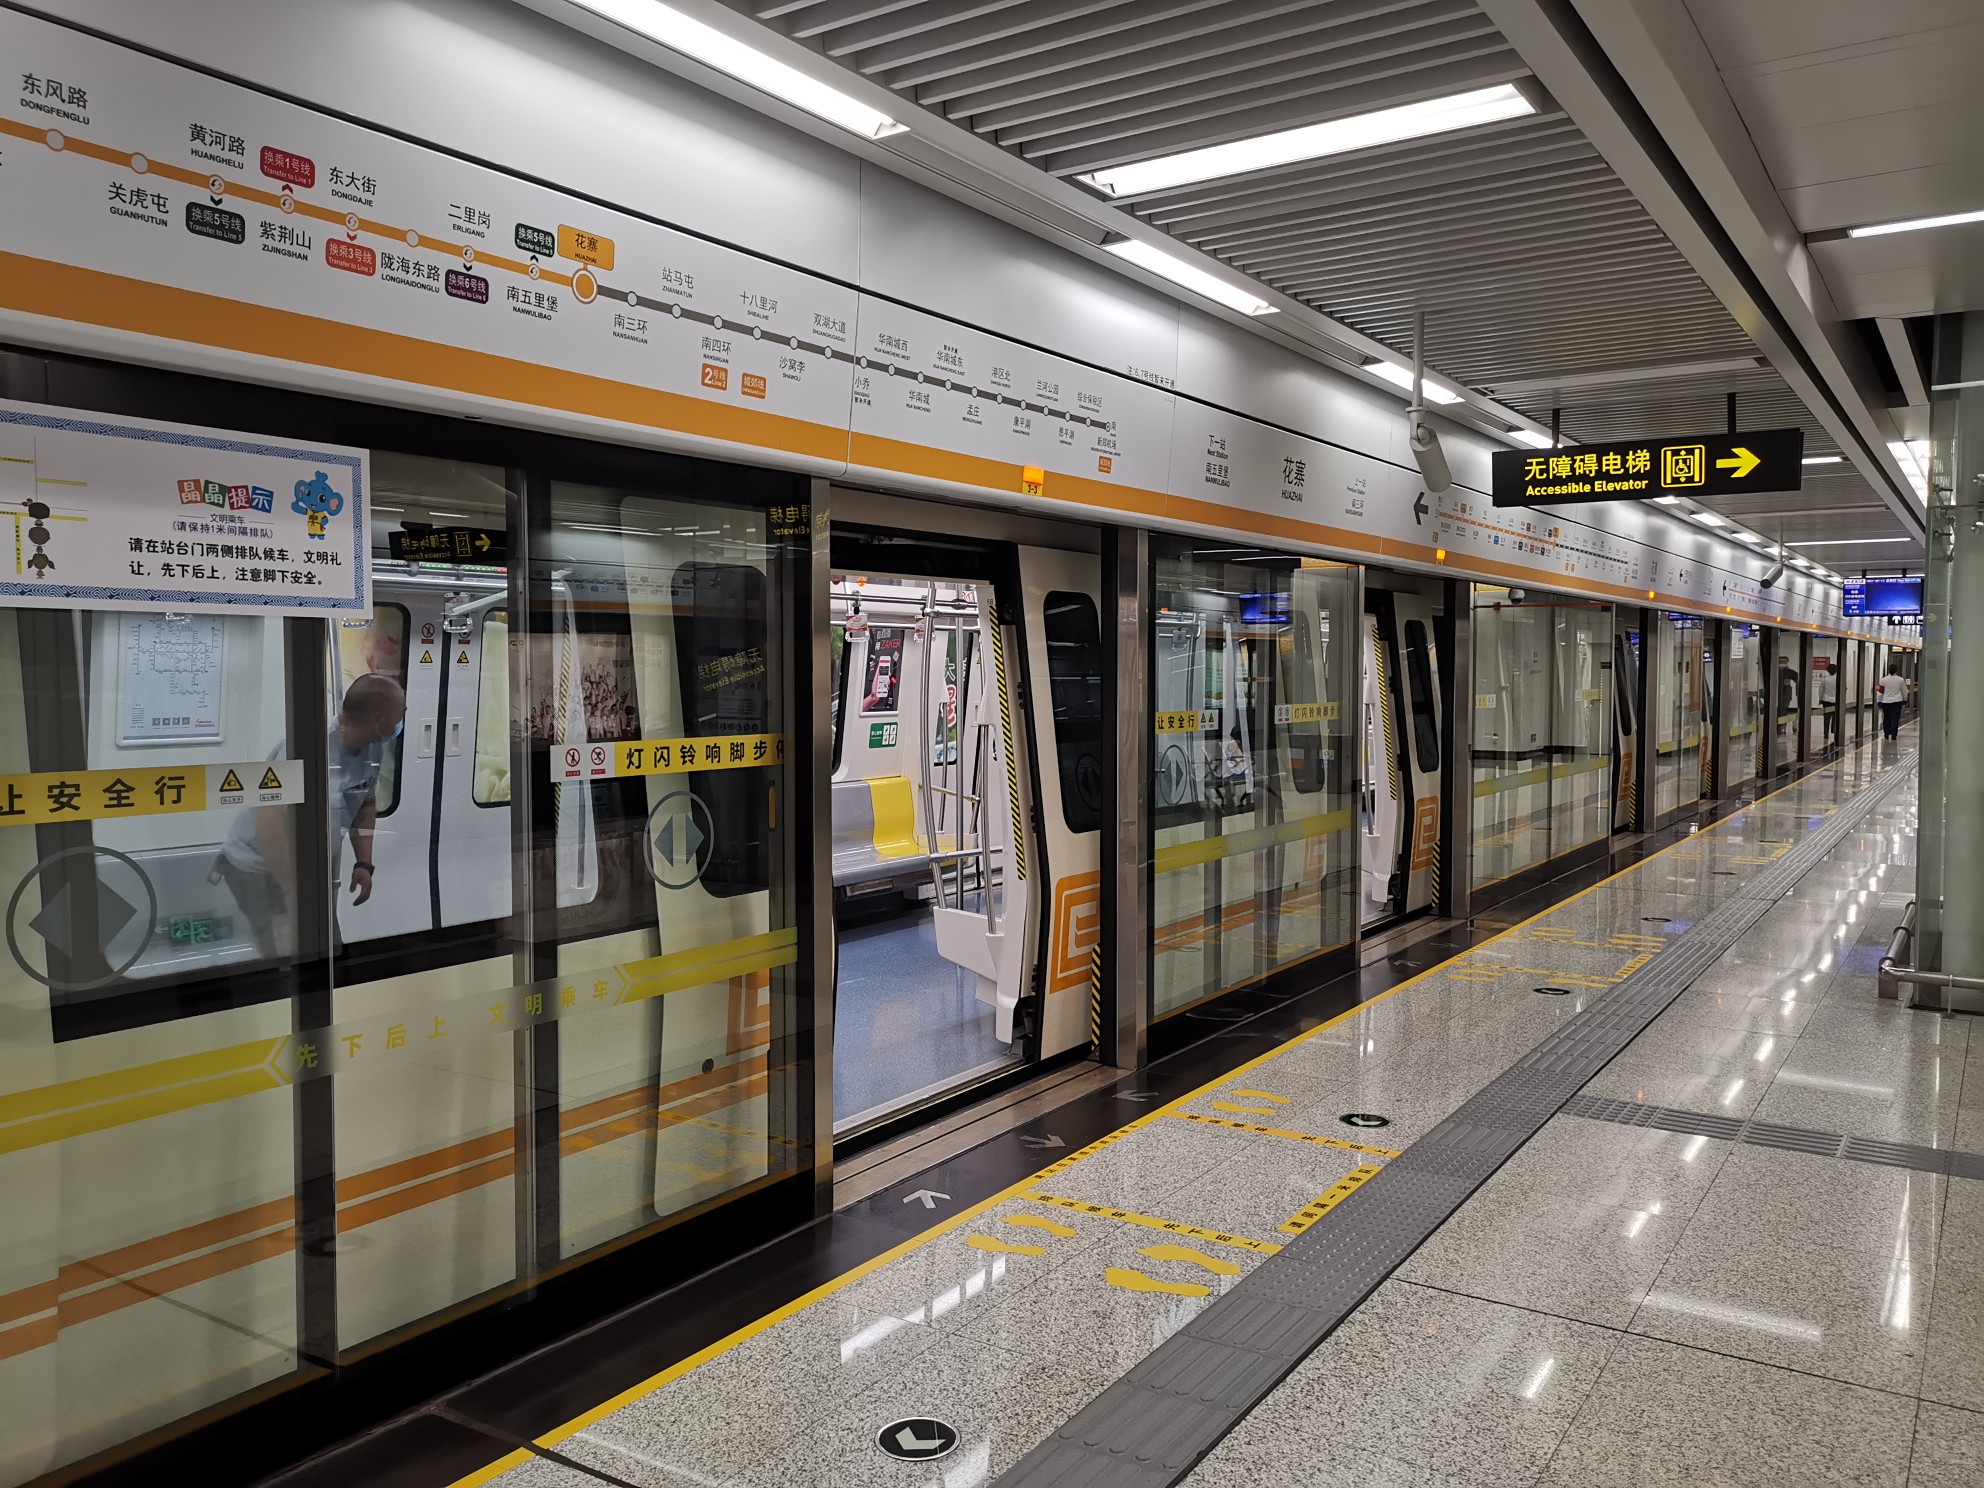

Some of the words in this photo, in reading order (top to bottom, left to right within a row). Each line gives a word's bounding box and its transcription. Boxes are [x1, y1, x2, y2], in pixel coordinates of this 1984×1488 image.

[22, 72, 89, 109] 东风路
[20, 98, 90, 126] DONGFENGLU
[189, 122, 246, 157] 黄河路
[190, 148, 244, 170] HUANGHELU
[264, 150, 311, 177] 换乘1号线
[263, 165, 287, 178] Transfer
[294, 174, 307, 184] Line
[329, 166, 377, 195] 东大街
[108, 181, 169, 214] 关虎屯
[331, 189, 374, 208] DONGDAJIE
[109, 205, 168, 227] GUANHUTUN
[191, 206, 242, 232] 换乘5号线
[448, 203, 491, 229] 二里岗
[189, 221, 216, 235] Transfer
[216, 228, 223, 236] to
[223, 231, 237, 240] Line
[260, 220, 312, 250] 紫荆山
[452, 223, 485, 239] ERLIGANG
[518, 226, 553, 248] 换乘5号线
[517, 239, 535, 250] Transfer
[540, 245, 549, 254] Line
[574, 232, 599, 253] 花寨
[262, 244, 308, 261] ZIJINGSHAN
[329, 242, 372, 265] 换乘3号线
[574, 252, 597, 264] HUAZHAI
[328, 256, 351, 268] Transfer
[350, 261, 357, 269] to
[356, 264, 368, 272] Line
[380, 252, 441, 283] 陇海东路
[381, 273, 440, 294] LONGHAIDONGLU
[448, 273, 486, 294] 换乘6号线
[662, 267, 694, 290] 站马屯
[447, 286, 467, 297] Transfer
[472, 292, 482, 300] Line
[506, 285, 559, 313] 南五里堡
[662, 285, 693, 299] ZHANMATUN
[739, 291, 778, 314] 十八里河
[512, 306, 552, 321] NANWULIBAO
[747, 309, 769, 321] SHIBALIHE
[613, 313, 648, 335] 南三环
[813, 313, 847, 334] 双湖大道
[612, 331, 648, 345] NANSANHUAN
[701, 336, 732, 356] 南四环
[878, 332, 909, 352] 华南城西
[703, 353, 729, 365] NANSIHUAN
[779, 356, 806, 374] 沙窝李
[936, 351, 964, 368] 华南城东
[854, 376, 870, 391] 小乔
[991, 366, 1011, 382] 港区北
[908, 389, 930, 406] 华南城
[966, 404, 980, 418] 孟庄
[1208, 434, 1226, 451] 下一站
[1207, 448, 1216, 457] Next
[1216, 450, 1229, 461] Station
[1205, 462, 1229, 479] 南五里堡
[1282, 456, 1306, 488] 花寨
[1524, 448, 1650, 481] 无障碍电梯
[1027, 484, 1038, 495] 3-3
[1205, 475, 1231, 488] NANWULIBAO
[1526, 480, 1591, 497] Accessible
[1594, 478, 1648, 493] Elevator
[181, 481, 274, 511] 晶晶提示
[1281, 488, 1304, 503] HUAZHAI
[209, 513, 246, 525] 文明乘车
[173, 520, 274, 539] (请保持1米间隔排队)
[128, 537, 342, 566] 请在站台门两侧排队候车，文明礼
[129, 560, 324, 586] 让，先下后上，注意脚下安全。
[881, 639, 901, 650] ZAKER
[1157, 714, 1196, 730] 让安全行
[1293, 705, 1336, 720] 灯闪铃响脚步
[295, 1015, 448, 1070] 先下后上
[488, 979, 609, 1025] 文明乘车
[1301, 1136, 1389, 1156] 先下后上
[1163, 1222, 1261, 1249] 先下后上
